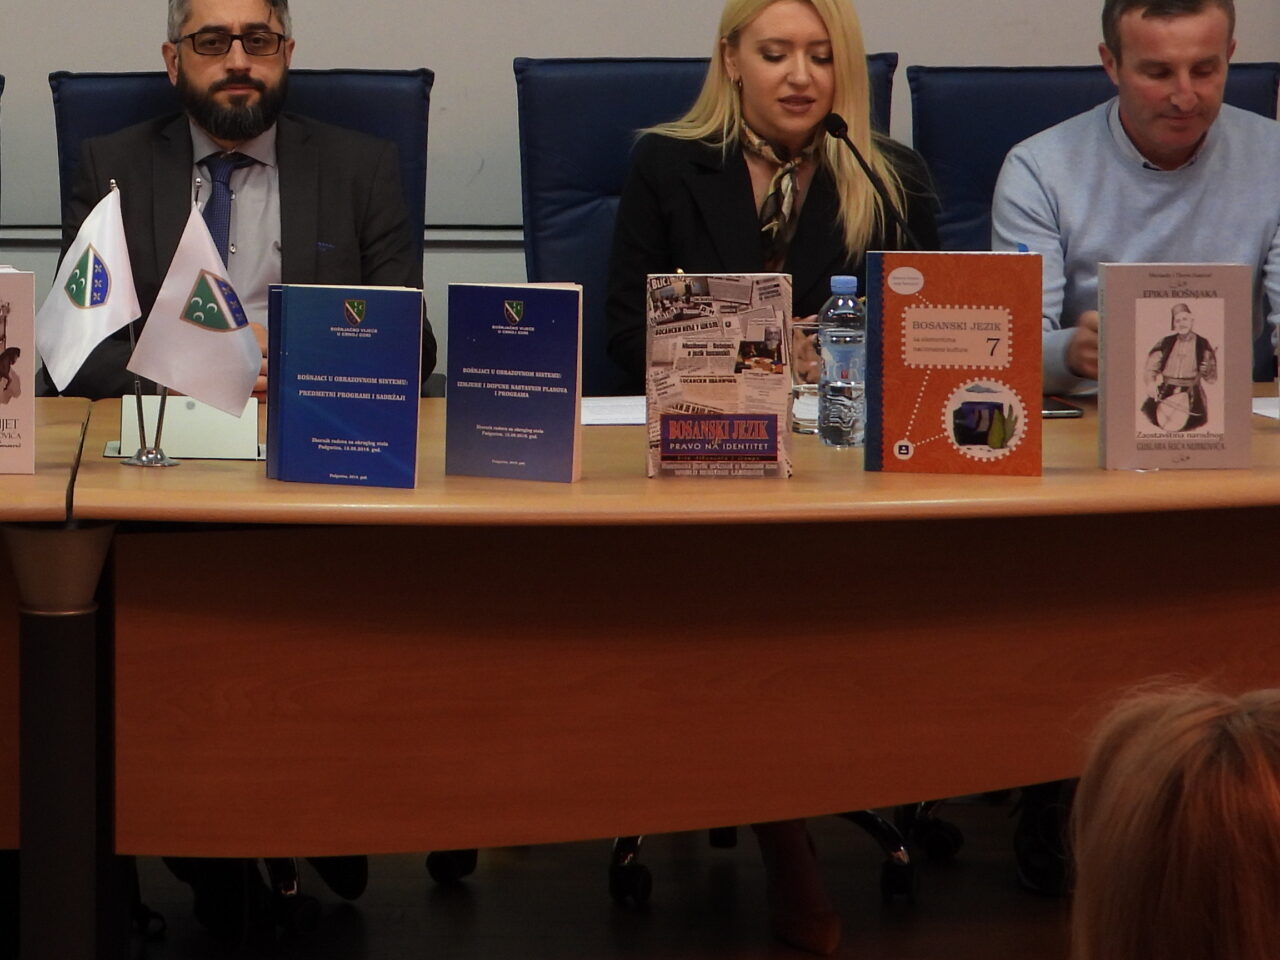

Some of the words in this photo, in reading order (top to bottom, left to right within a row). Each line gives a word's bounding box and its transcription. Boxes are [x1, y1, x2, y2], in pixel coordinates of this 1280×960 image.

[912, 320, 967, 331] BOSANSKI
[970, 321, 1002, 332] JEZIK
[986, 337, 1000, 357] 7
[297, 374, 328, 382] BOŠNJACI
[334, 376, 378, 384] OBRAZOVNOM
[337, 391, 371, 399] PROGRAMI
[376, 393, 406, 401] SADRŽAJI
[669, 420, 729, 439] BOSANSKI
[733, 420, 769, 439] JEZIK
[705, 442, 720, 450] NA
